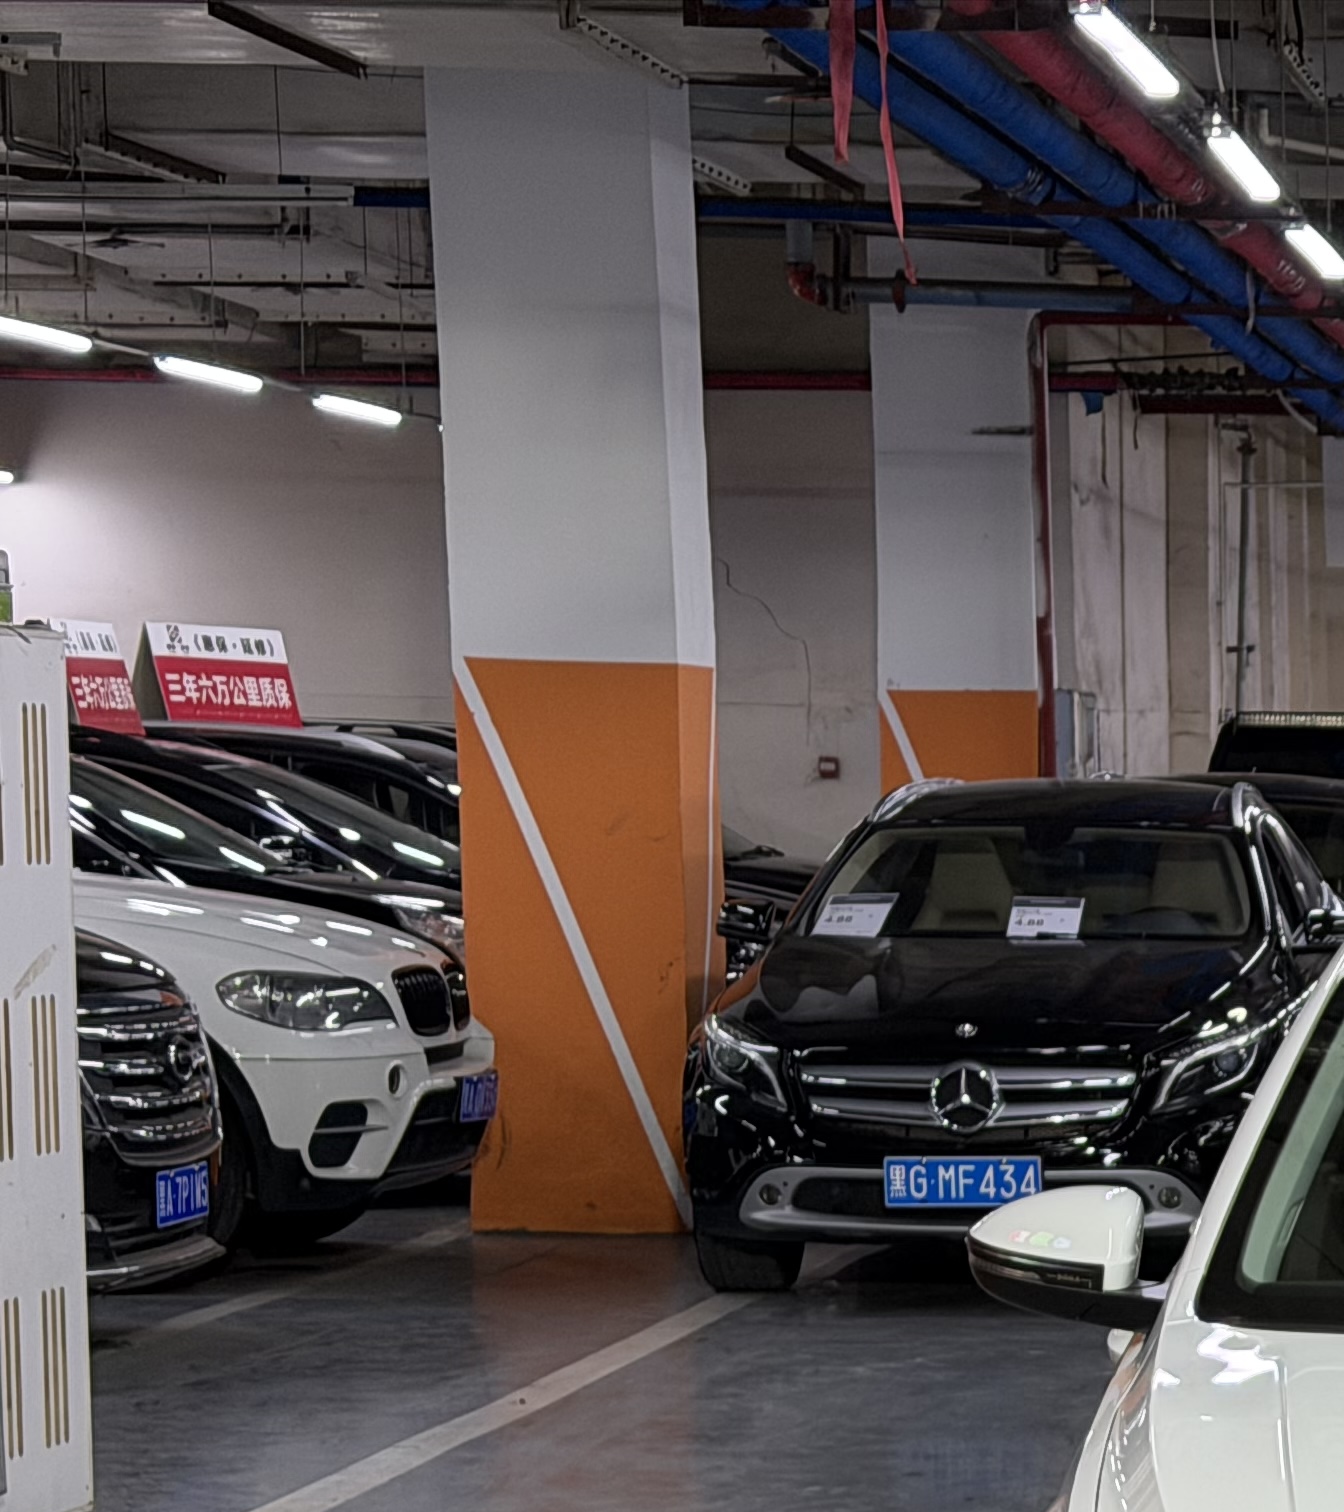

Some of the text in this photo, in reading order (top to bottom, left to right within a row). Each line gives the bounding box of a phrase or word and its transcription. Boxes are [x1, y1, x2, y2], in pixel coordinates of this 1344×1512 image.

[165, 671, 292, 710] 三年六万公里质保
[890, 1164, 1037, 1199] 黑G·MF434
